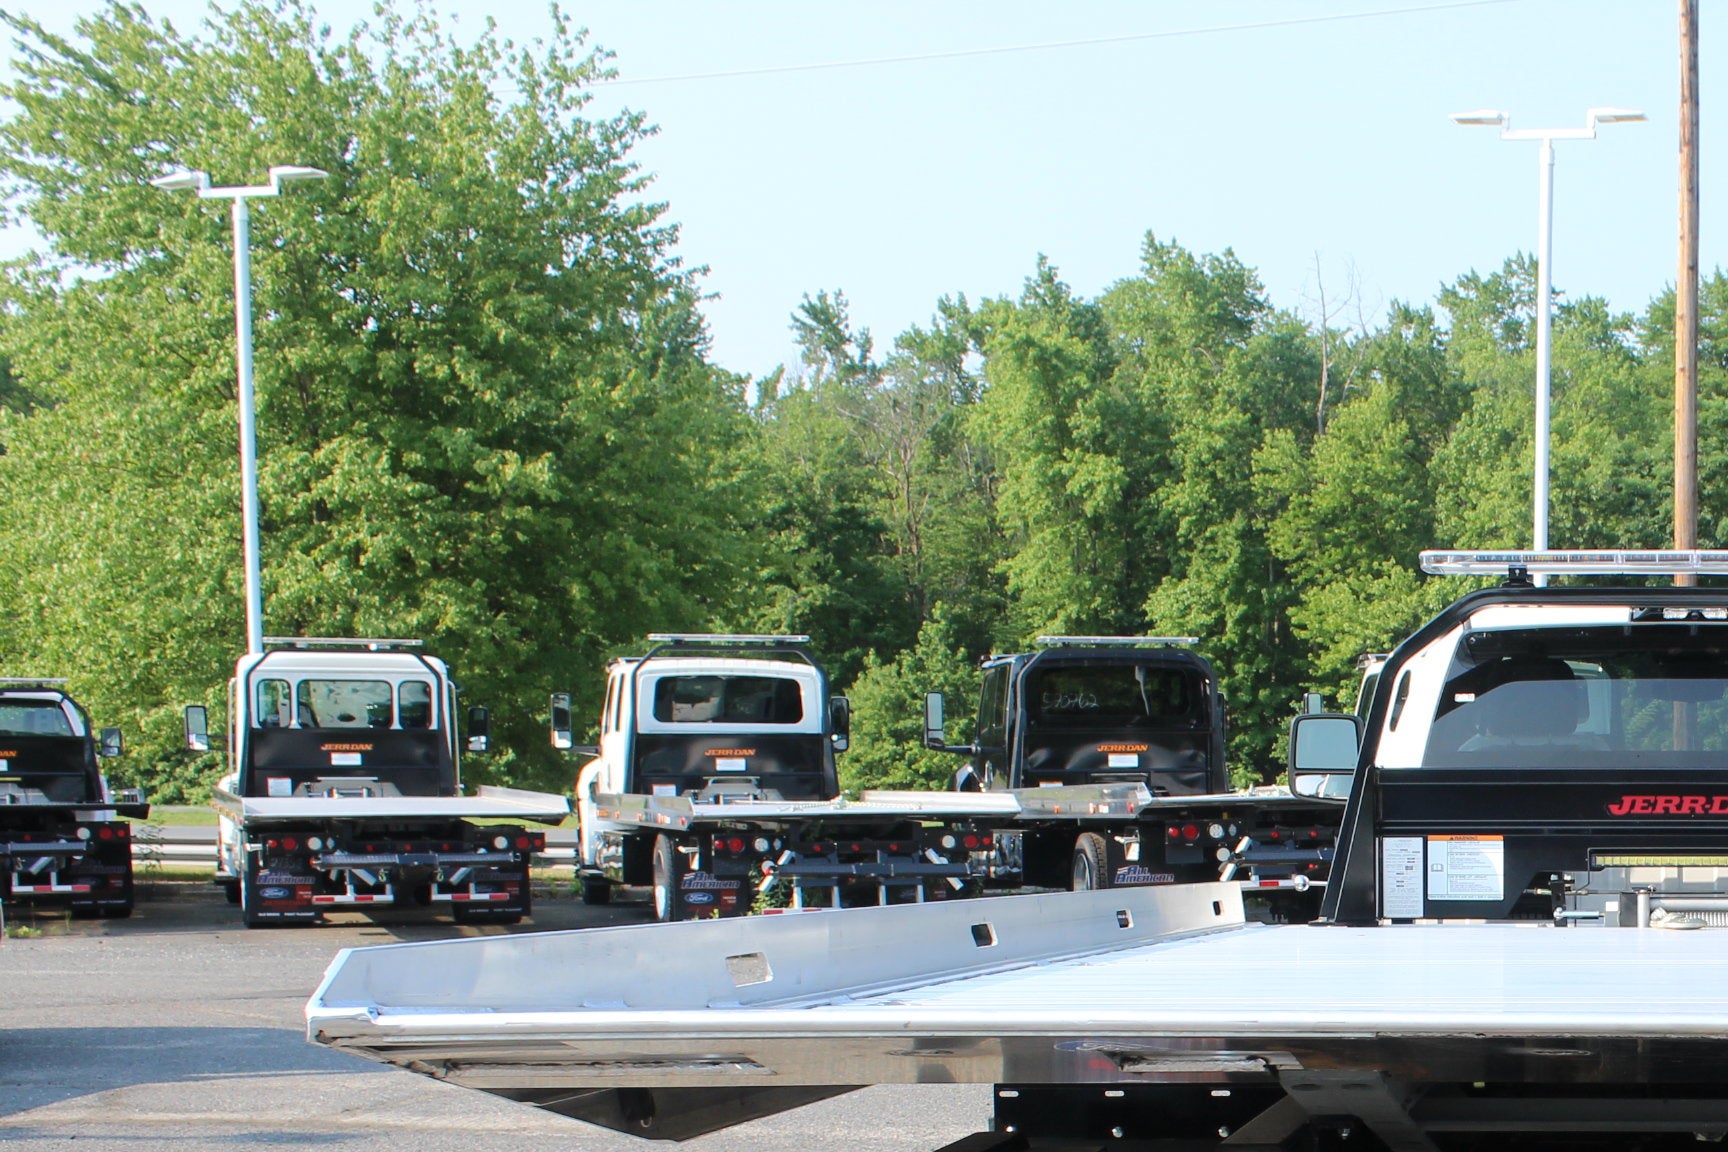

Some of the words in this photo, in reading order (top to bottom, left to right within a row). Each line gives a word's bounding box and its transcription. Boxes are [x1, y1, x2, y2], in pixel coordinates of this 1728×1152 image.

[320, 743, 373, 751] JERR-DAN
[1096, 744, 1149, 752] JERR-DAN
[704, 748, 756, 756] JERR-DAN
